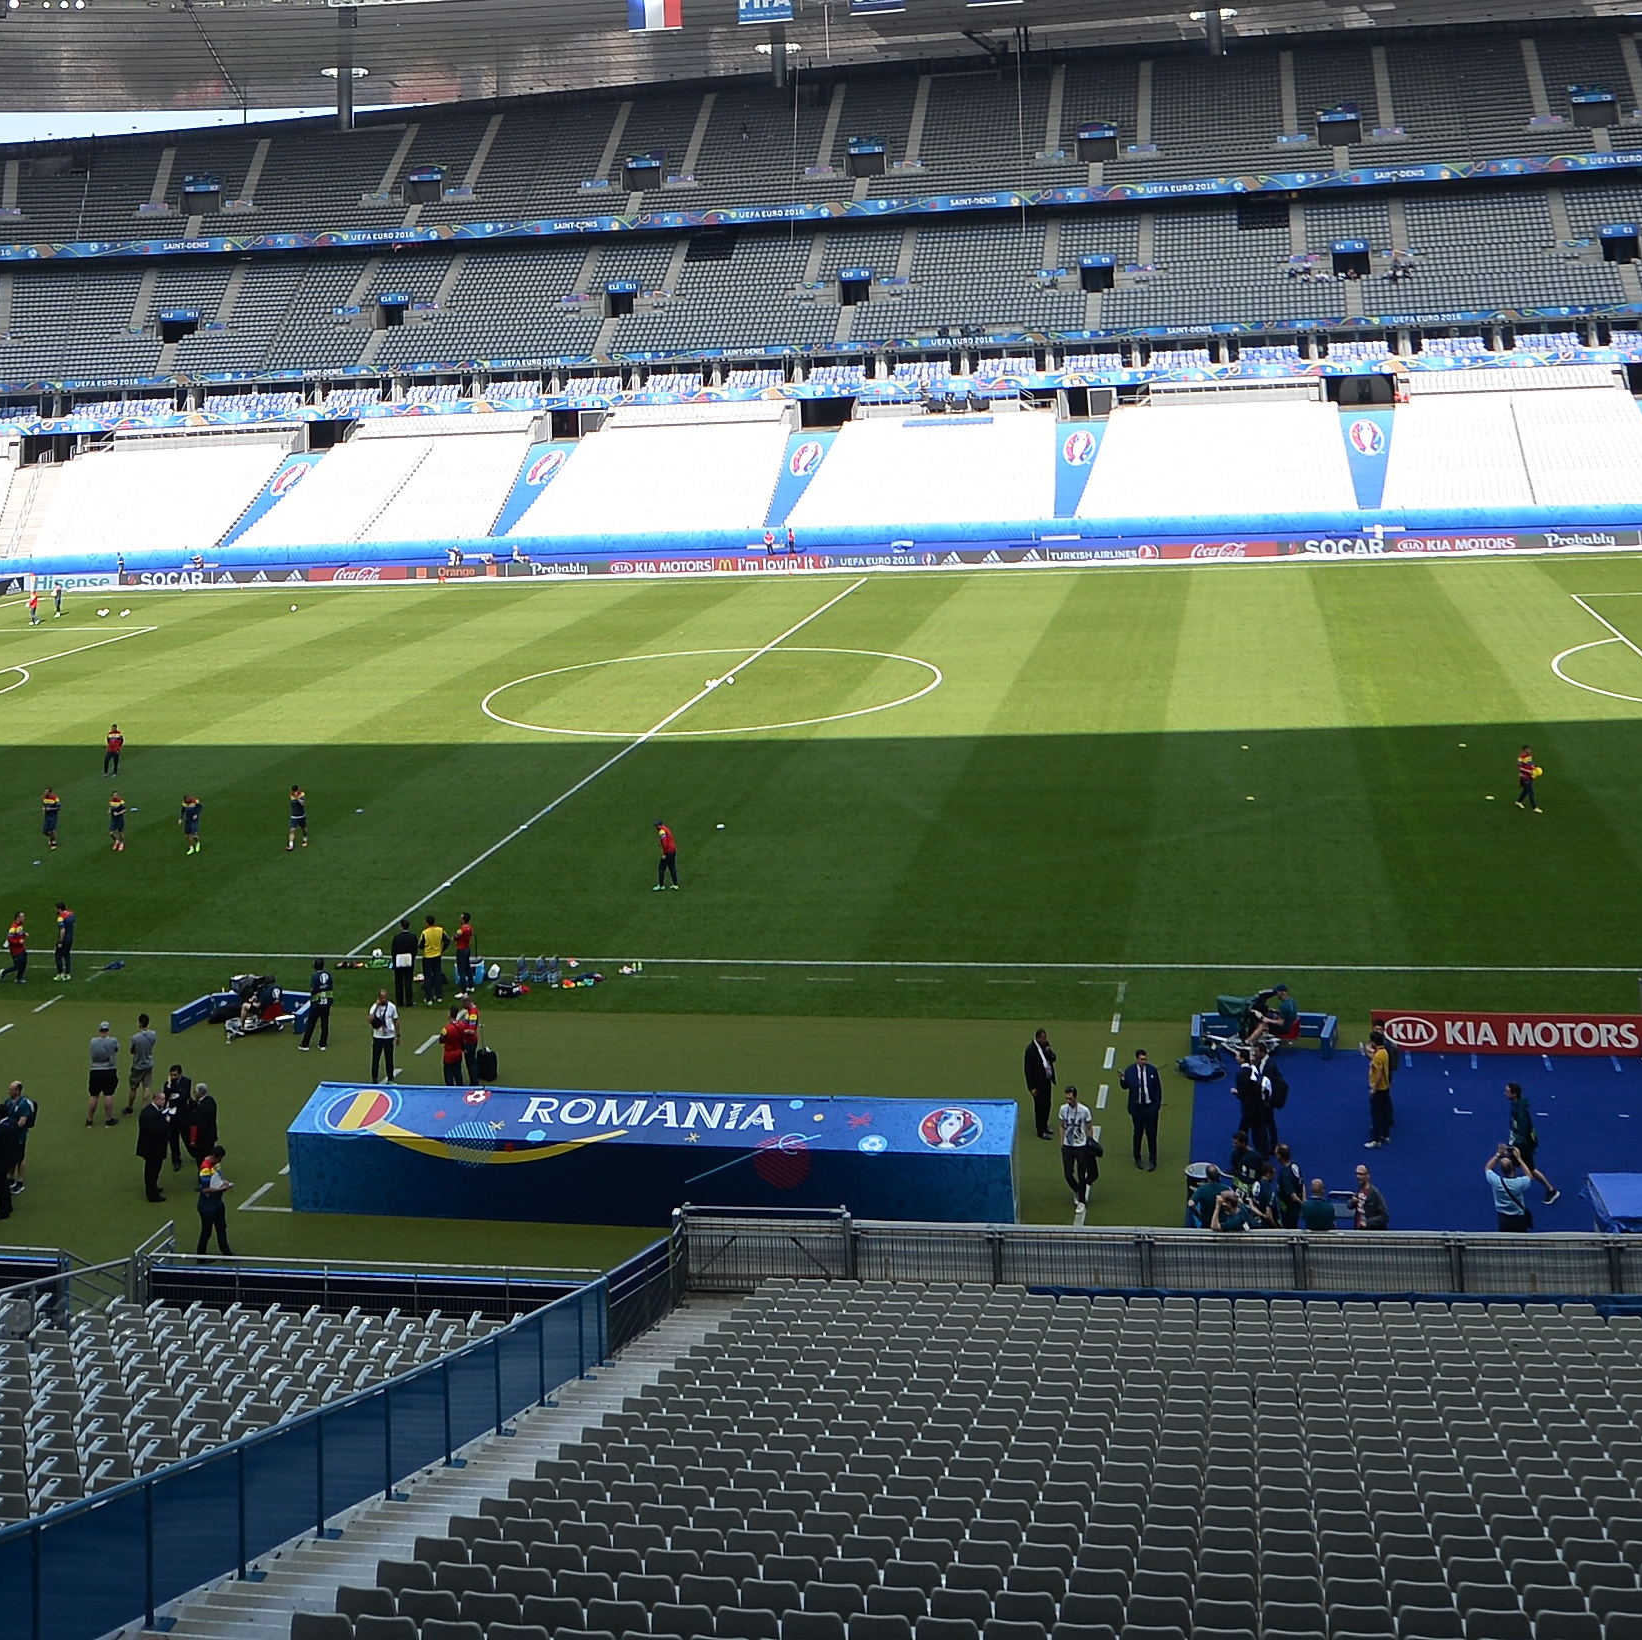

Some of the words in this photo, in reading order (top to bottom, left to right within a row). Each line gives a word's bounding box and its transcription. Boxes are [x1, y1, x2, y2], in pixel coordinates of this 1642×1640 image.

[1590, 155, 1615, 165] UEFA
[1616, 154, 1641, 163] EURO
[1146, 185, 1169, 194] UEFA
[1170, 184, 1193, 193] EURO
[1195, 182, 1217, 191] 2016
[738, 211, 760, 219] UEFA
[761, 210, 783, 218] EURO
[784, 208, 805, 217] 2016
[351, 233, 371, 241] UEFA
[372, 232, 393, 240] EURO
[1304, 538, 1384, 555] SOCAR
[1427, 540, 1451, 551] KIA
[1455, 537, 1516, 550] MOTORS
[1544, 533, 1616, 547] Probably
[839, 558, 864, 566] UEFA
[866, 556, 891, 566] EURO
[892, 555, 916, 565] 2016
[1049, 550, 1092, 560] TURKISH
[1094, 549, 1137, 559] AIRLINES
[530, 562, 589, 576] Probably
[635, 562, 656, 573] KIA
[659, 560, 712, 572] MOTORS
[36, 572, 110, 590] Hisense
[140, 572, 204, 586] SOCAR
[1391, 1022, 1430, 1040] KIA
[1444, 1020, 1499, 1050] KIA
[1507, 1021, 1640, 1051] MOTORS
[517, 1096, 776, 1132] ROMANIA
